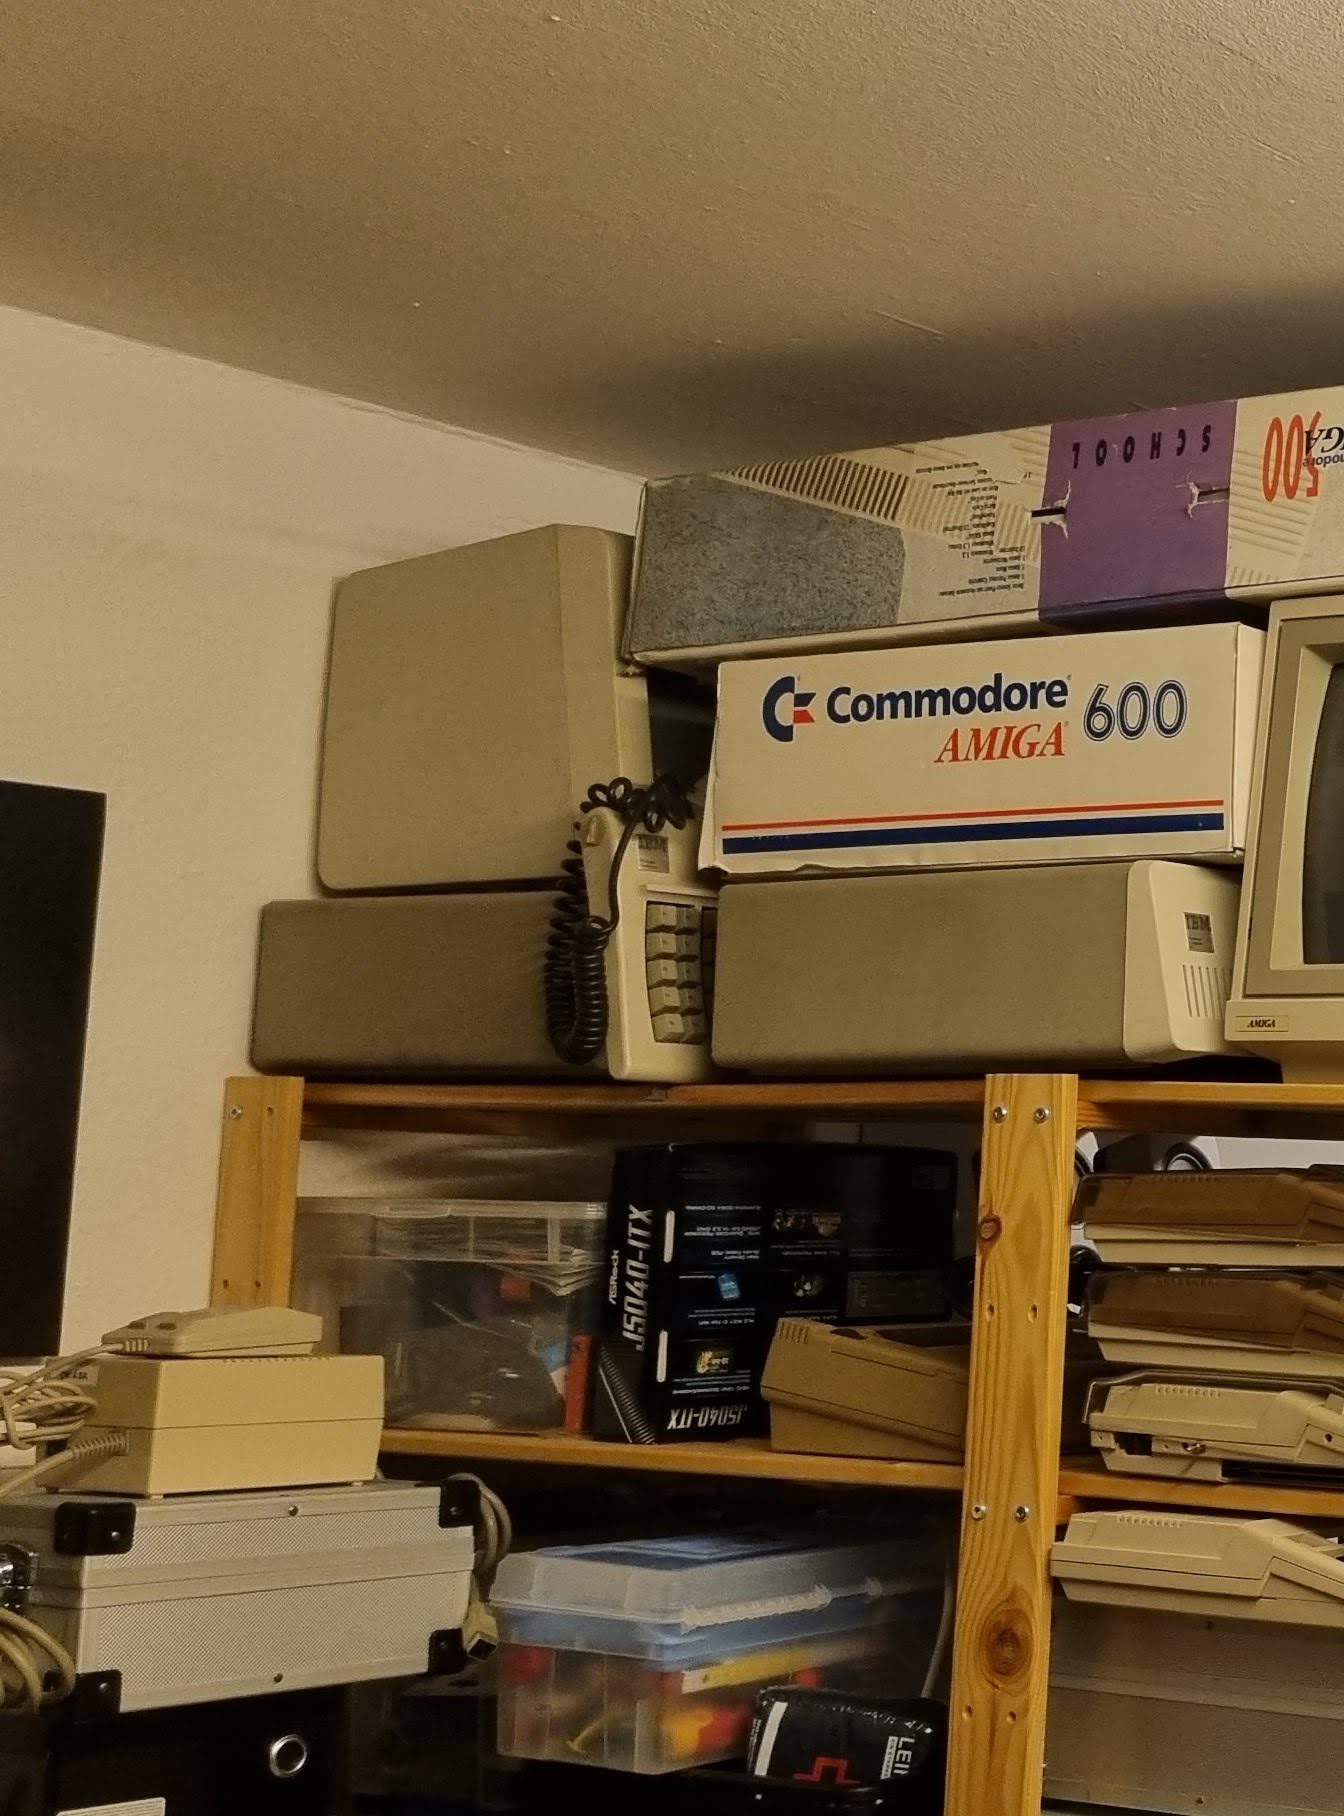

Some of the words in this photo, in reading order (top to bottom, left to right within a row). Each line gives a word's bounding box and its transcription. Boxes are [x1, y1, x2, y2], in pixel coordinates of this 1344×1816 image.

[1070, 424, 1213, 469] SCHOOL
[1262, 411, 1322, 503] 500
[826, 671, 1068, 725] Commodore
[1082, 678, 1188, 742] 600
[934, 723, 1067, 764] AMIGA
[608, 1249, 620, 1305] ASRock
[621, 1203, 654, 1351] J5040-ITX
[667, 1402, 748, 1431] J5040-ITX
